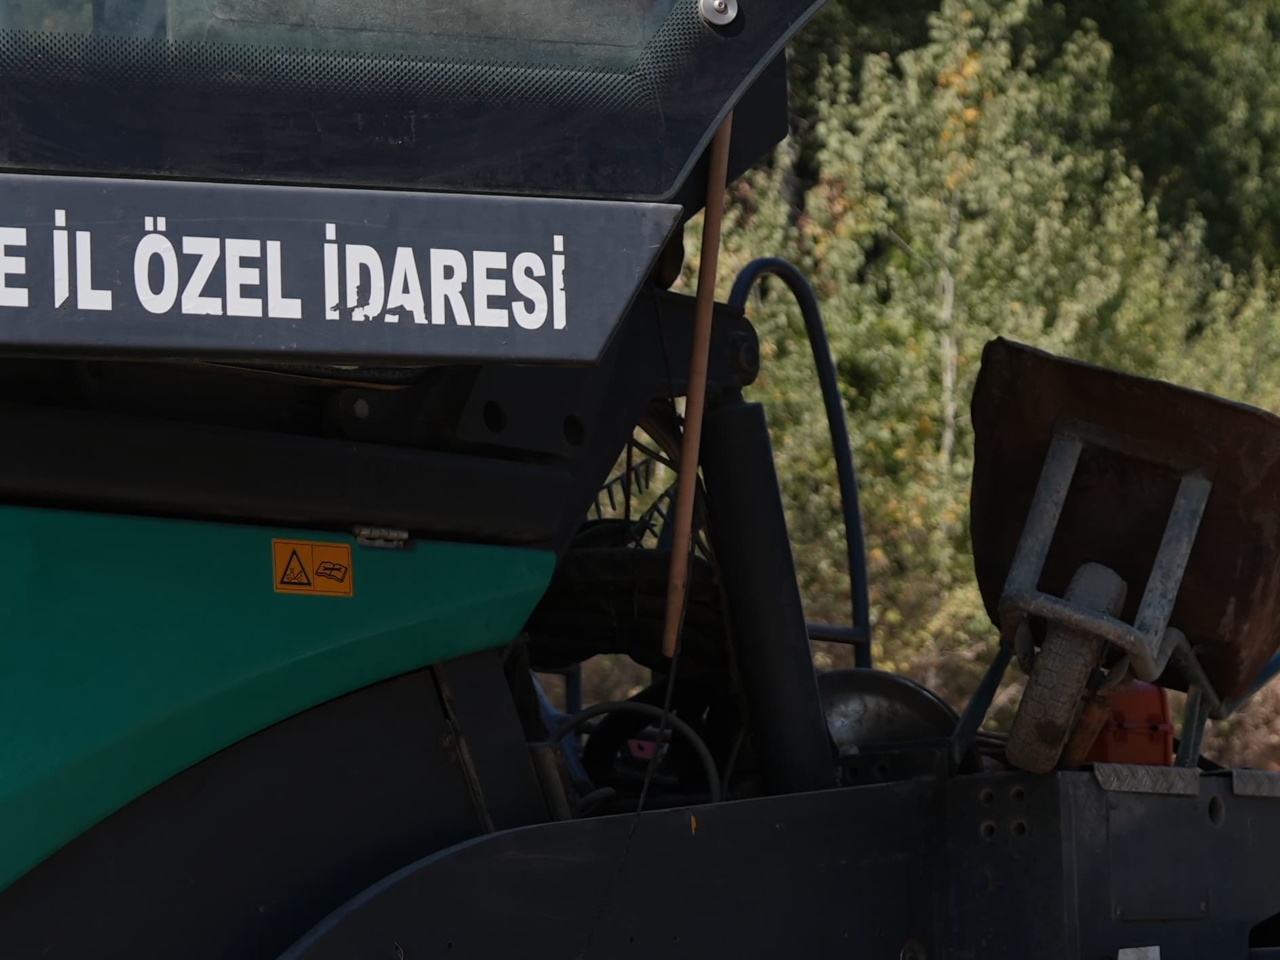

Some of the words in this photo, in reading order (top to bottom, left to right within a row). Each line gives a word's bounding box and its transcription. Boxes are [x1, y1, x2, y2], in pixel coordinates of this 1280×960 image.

[52, 208, 113, 311] İL
[133, 216, 303, 320] ÖZEL
[323, 222, 567, 330] İDARESİ
